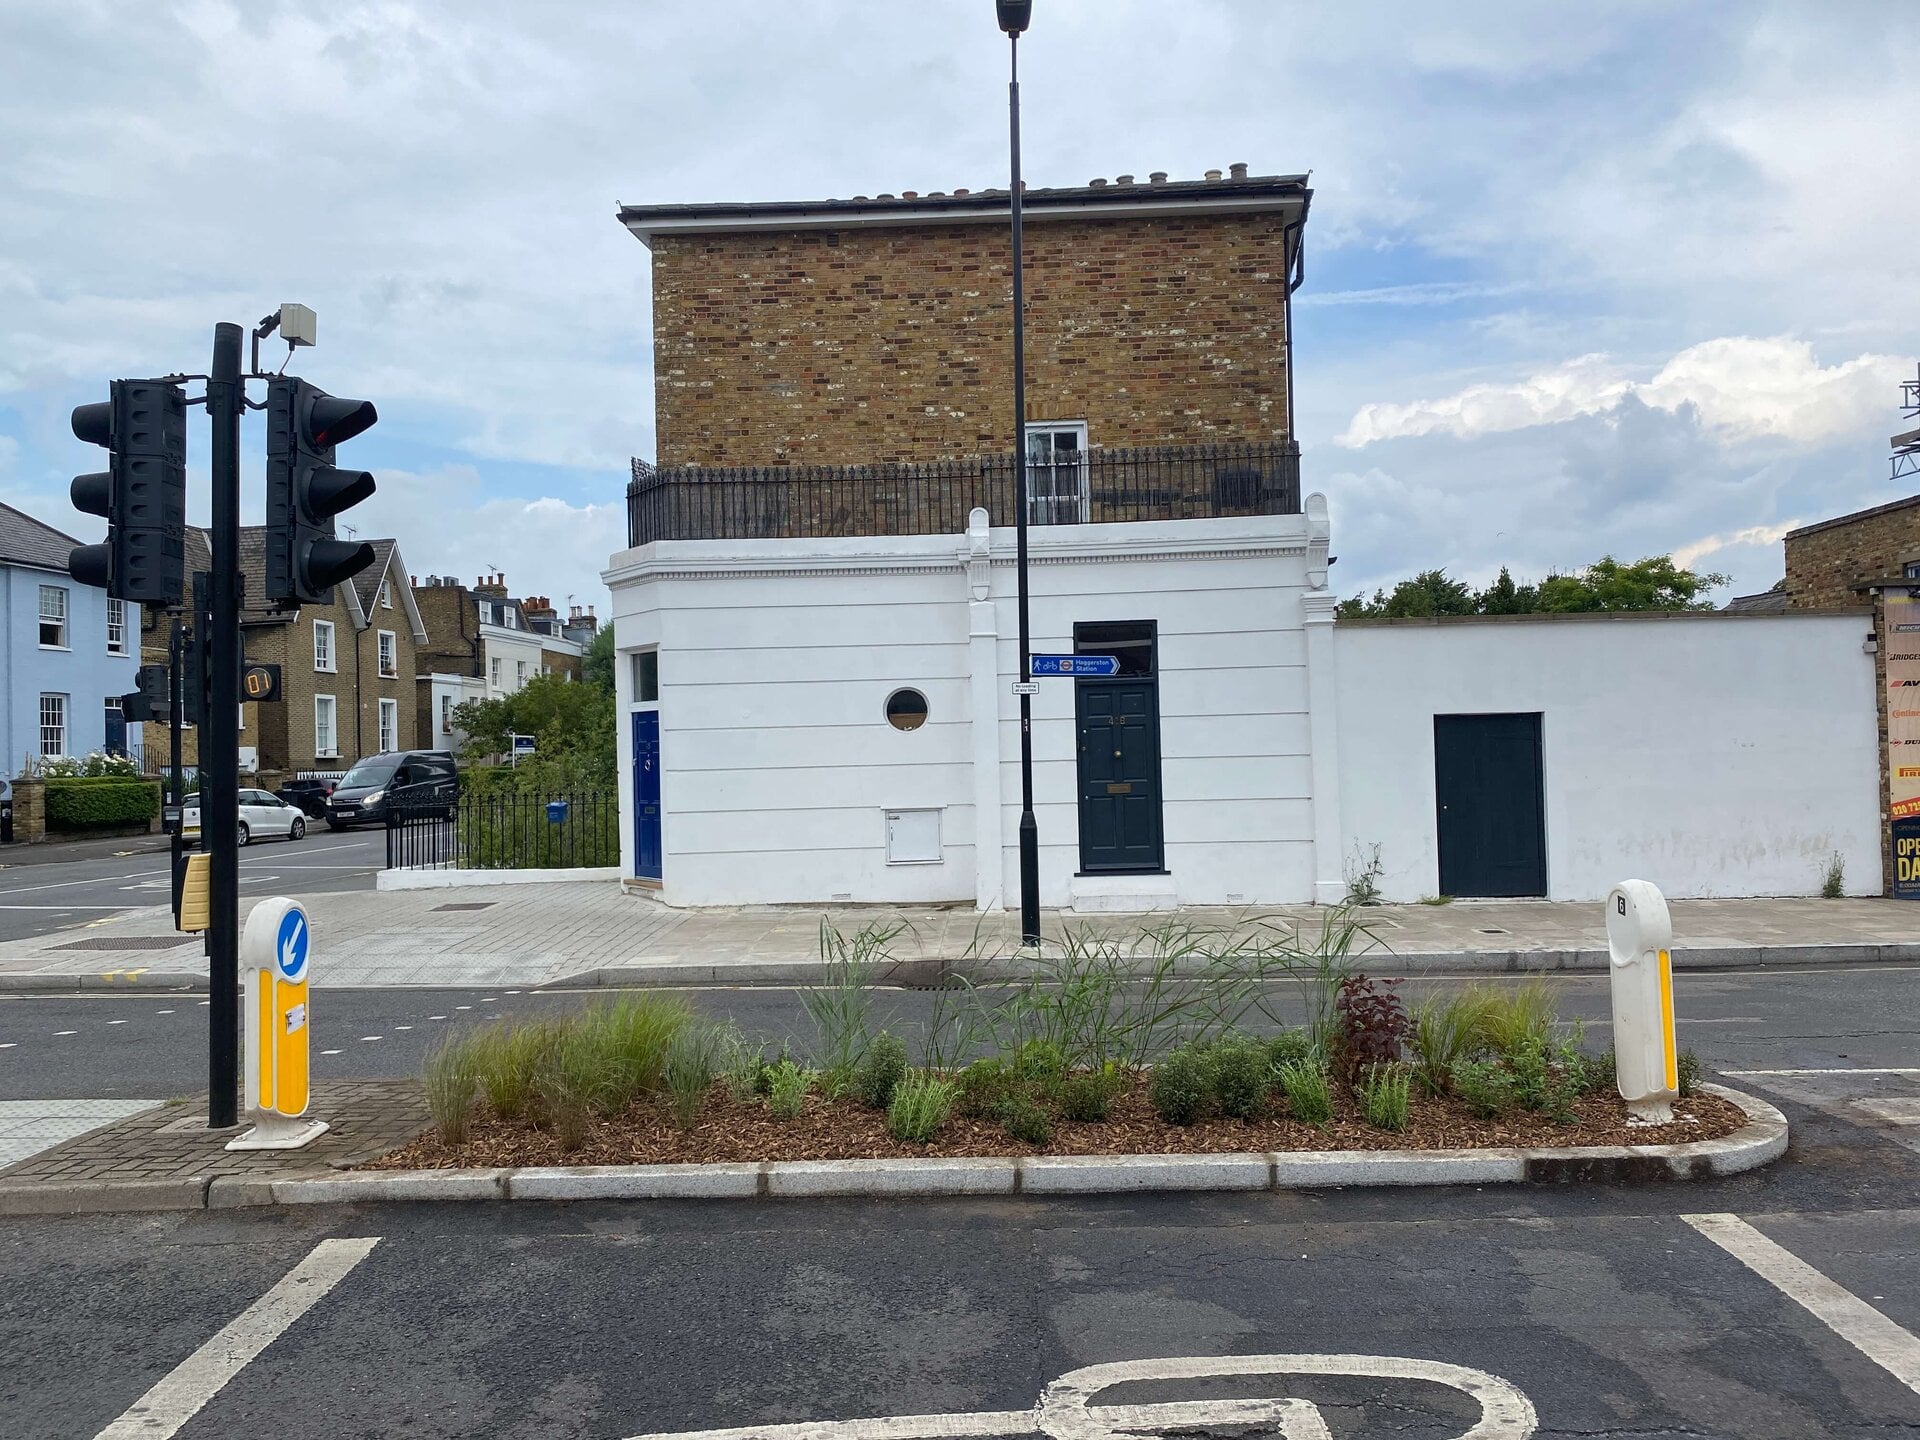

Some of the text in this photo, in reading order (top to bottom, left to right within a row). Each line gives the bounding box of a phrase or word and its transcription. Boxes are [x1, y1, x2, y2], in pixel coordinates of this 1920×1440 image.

[247, 672, 270, 694] 01
[1892, 805, 1907, 816] 020
[1897, 857, 1920, 881] DA
